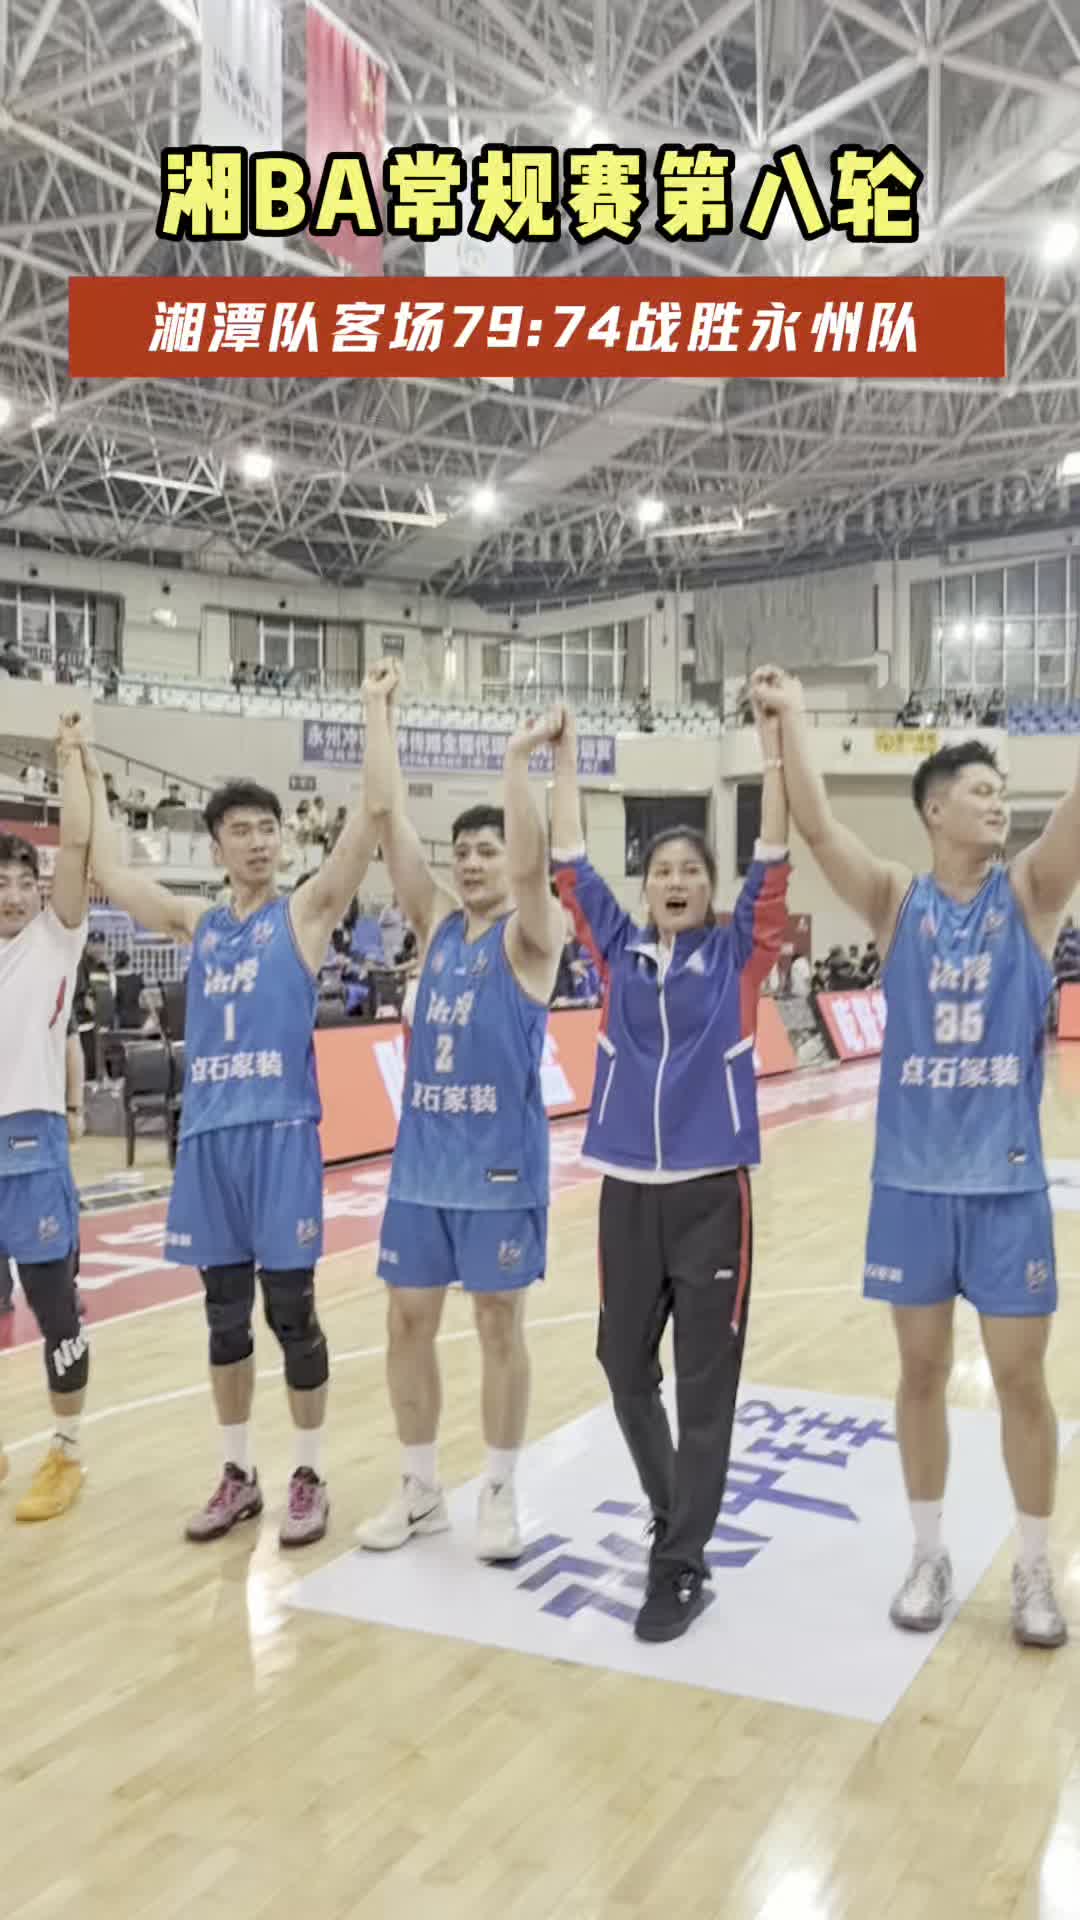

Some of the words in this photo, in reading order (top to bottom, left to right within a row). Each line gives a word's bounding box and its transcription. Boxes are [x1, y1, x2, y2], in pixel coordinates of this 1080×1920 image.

[224, 1001, 236, 1042] 1
[434, 1034, 454, 1073] 2
[901, 1055, 1019, 1089] 点石家装
